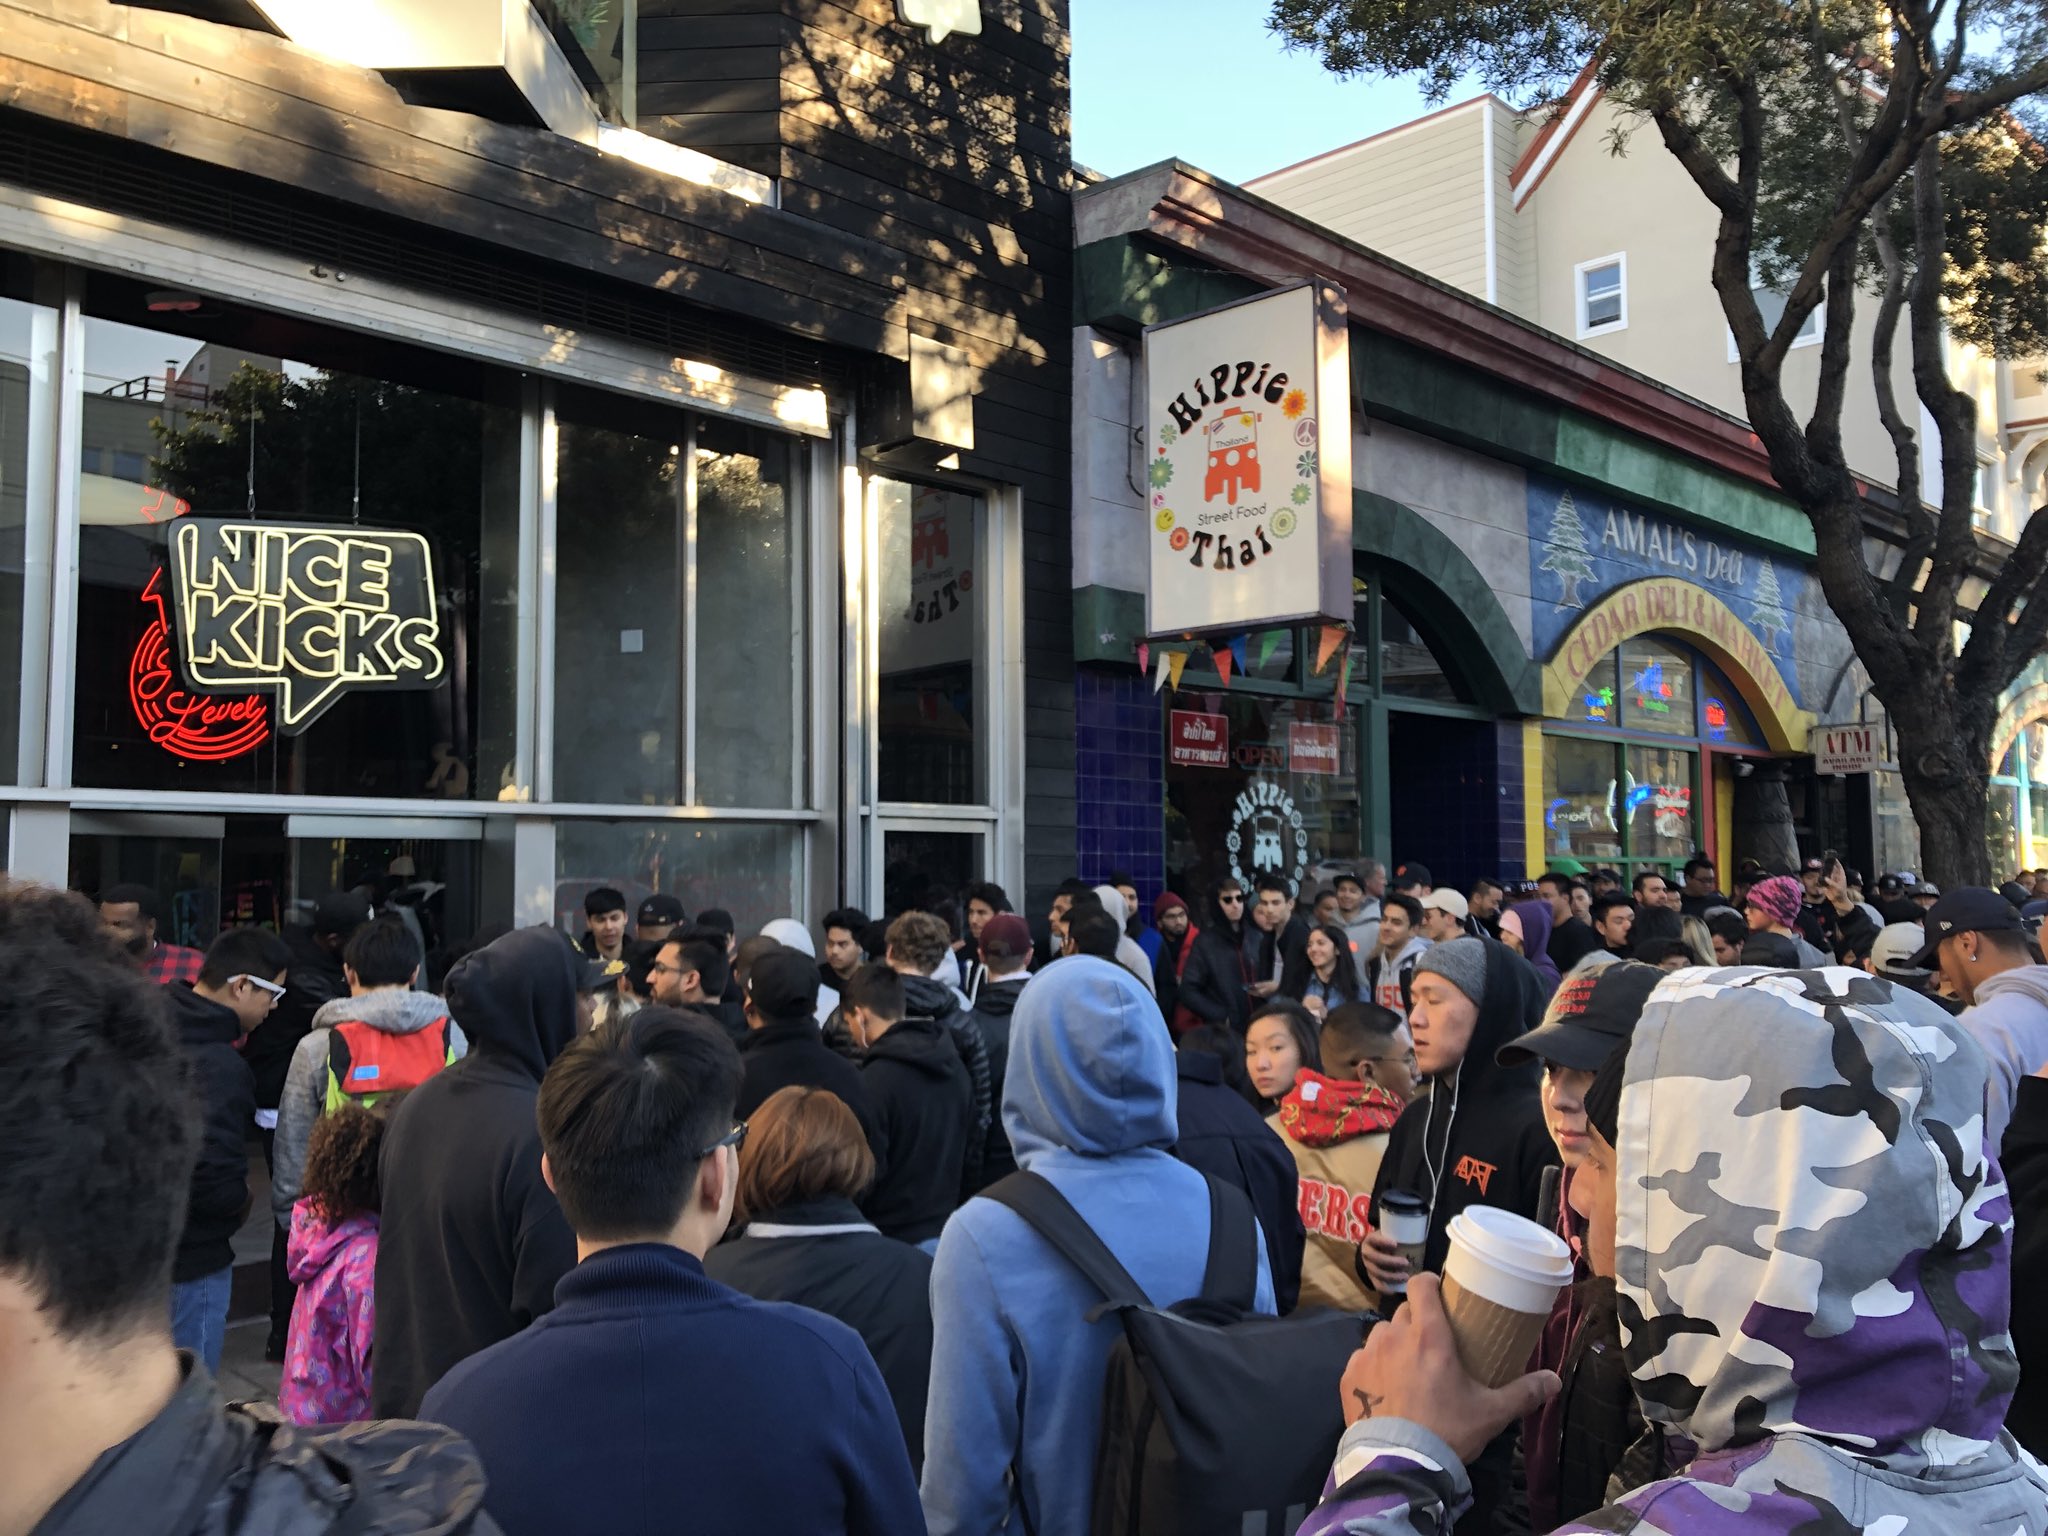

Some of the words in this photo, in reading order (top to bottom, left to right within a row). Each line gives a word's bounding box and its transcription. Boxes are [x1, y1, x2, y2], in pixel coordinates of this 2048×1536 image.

[1215, 436, 1249, 449] Thailand
[1198, 509, 1234, 526] Street
[1236, 503, 1267, 518] Food
[190, 527, 392, 611] NICE
[1190, 525, 1273, 570] Thai
[1602, 507, 1698, 572] AMAL'S
[1705, 542, 1745, 585] Deli
[188, 590, 444, 680] KICKS
[1567, 593, 1641, 678] CEDAR
[1645, 586, 1689, 622] DELI
[1693, 594, 1705, 626] &
[1710, 602, 1786, 710] MARKET
[150, 692, 267, 742] Level
[1236, 746, 1284, 766] OPEN
[1826, 730, 1871, 754] ATM
